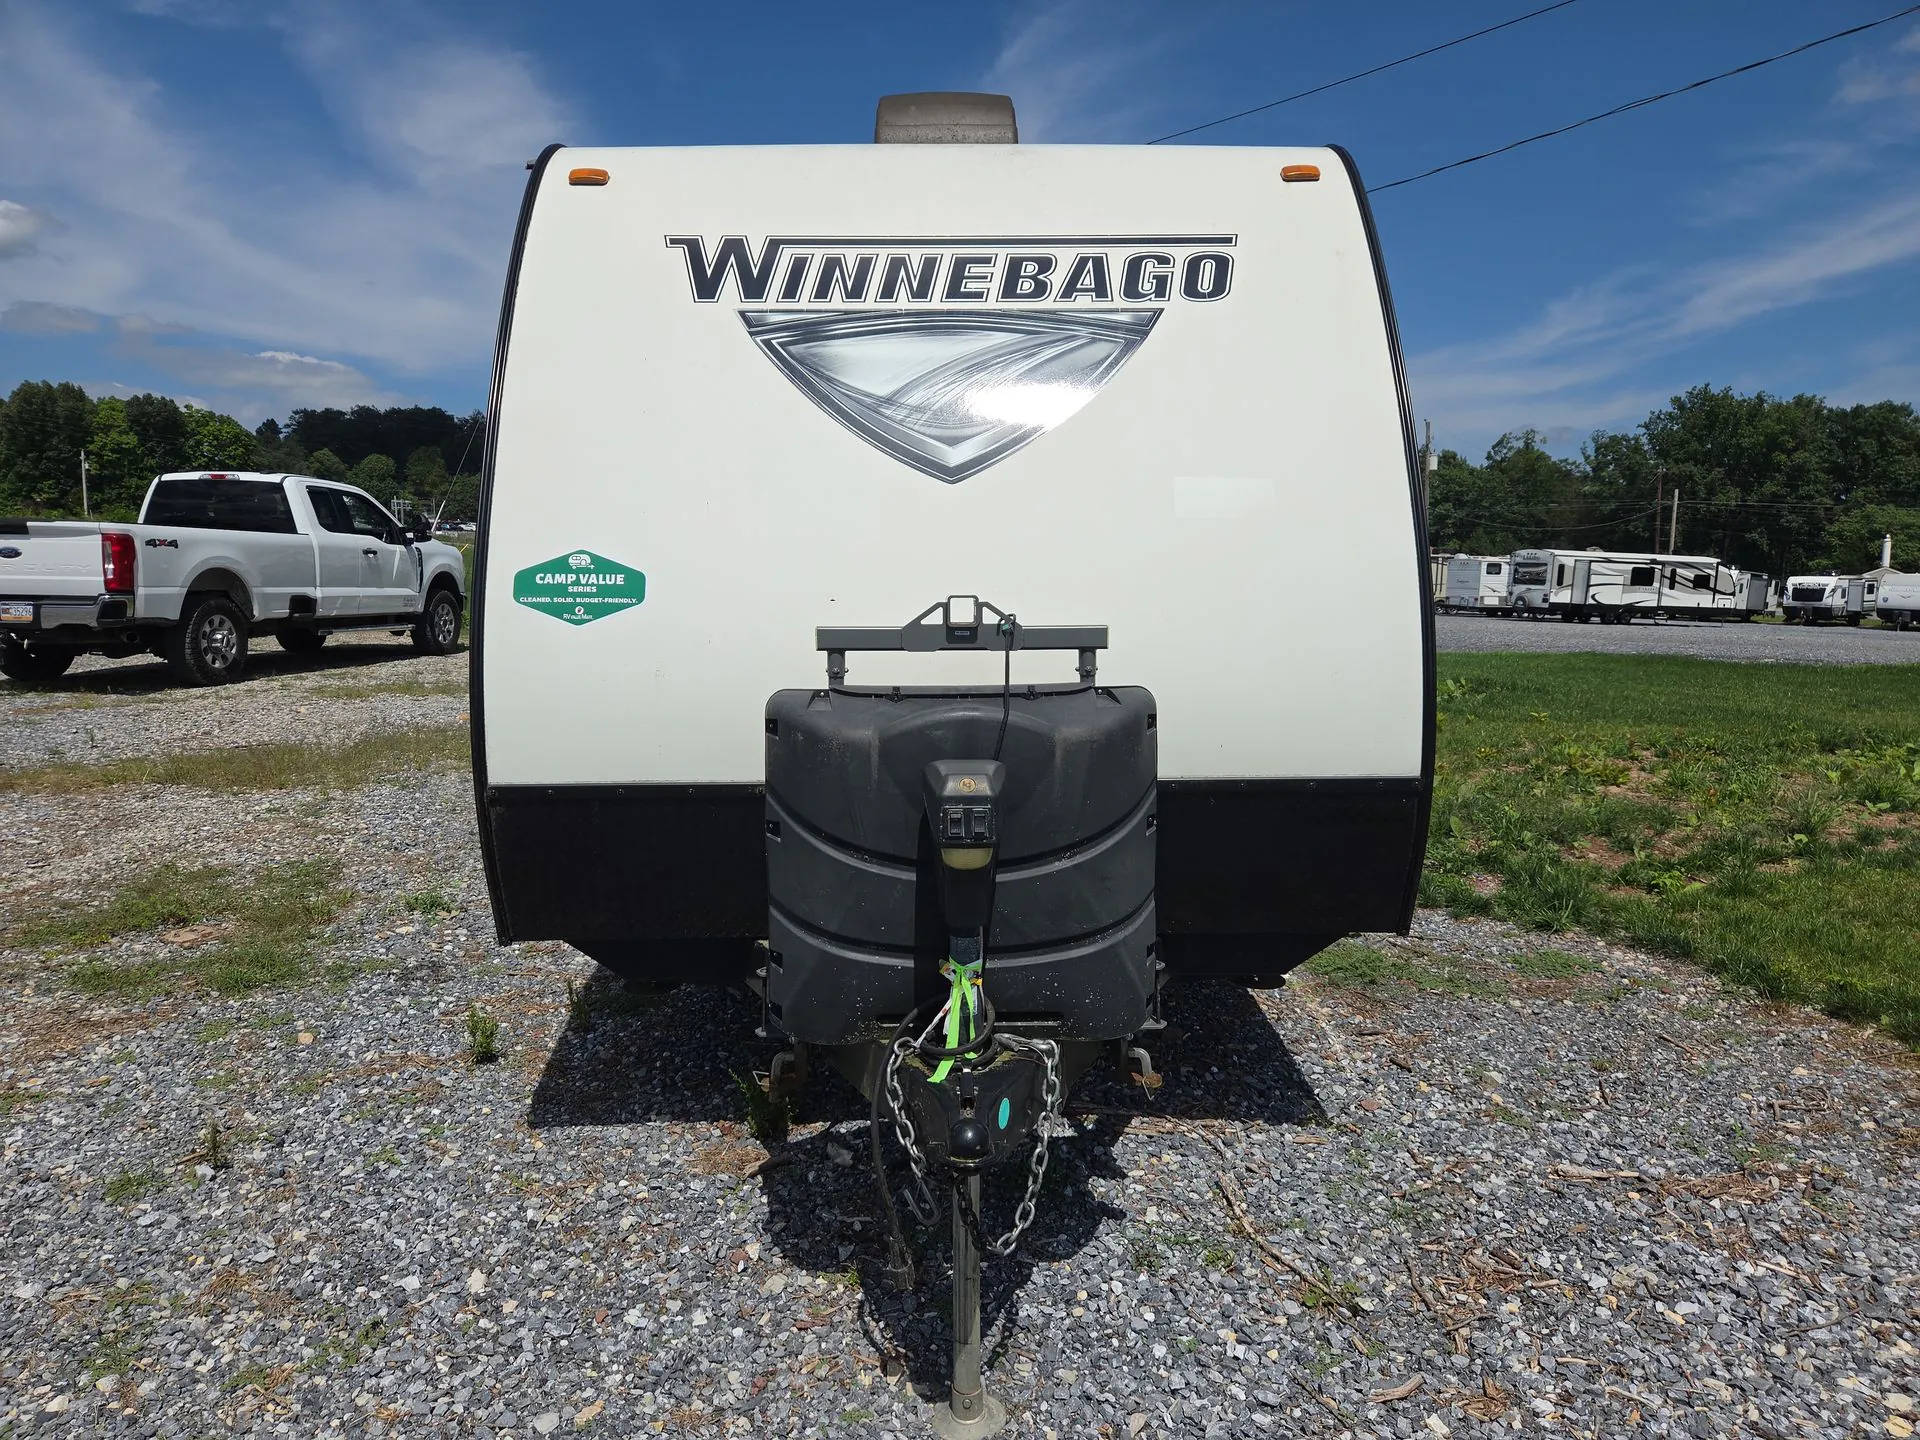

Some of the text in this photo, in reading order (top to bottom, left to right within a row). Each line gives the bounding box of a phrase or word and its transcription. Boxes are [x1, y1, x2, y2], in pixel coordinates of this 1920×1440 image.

[664, 233, 1239, 304] WINNEBAGO
[536, 573, 624, 584] CAMP VALUE
